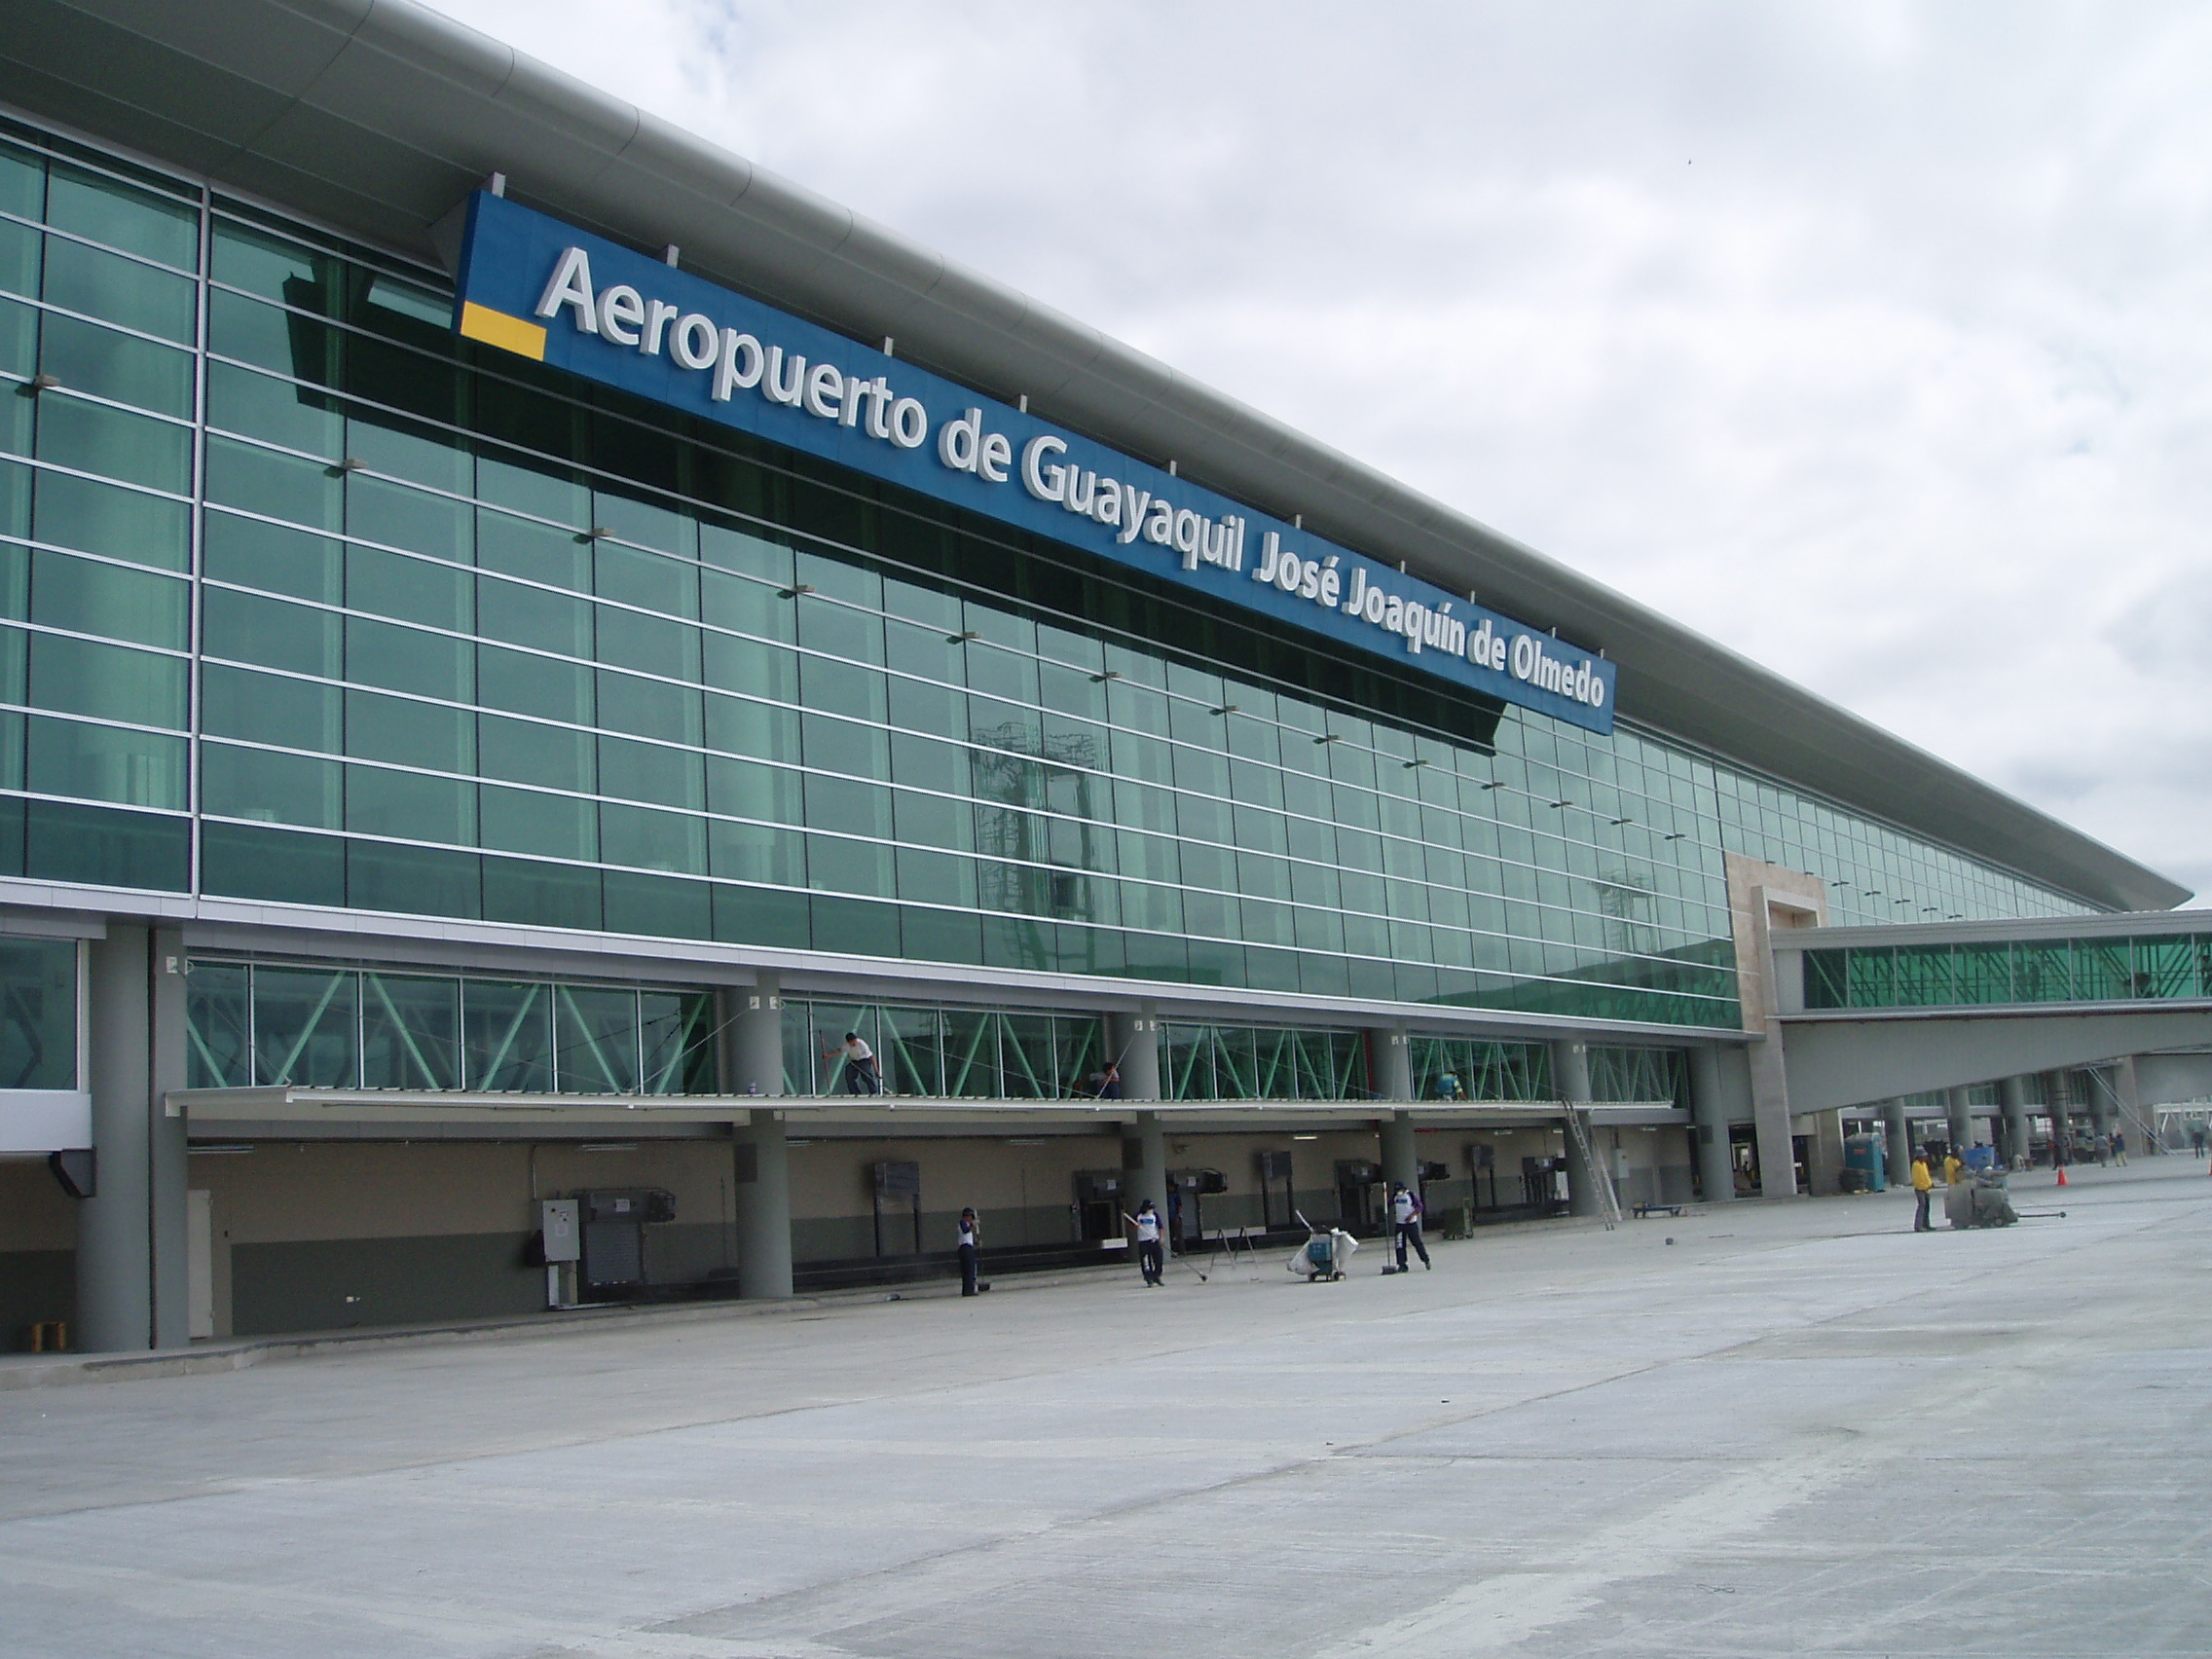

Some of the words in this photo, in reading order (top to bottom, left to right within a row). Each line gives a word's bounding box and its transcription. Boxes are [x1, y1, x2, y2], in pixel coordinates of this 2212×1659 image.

[535, 247, 928, 448] Aeropuerto
[940, 408, 1012, 482] de
[1022, 436, 1244, 571] Guayaquil
[1252, 532, 1340, 607] José
[1342, 568, 1466, 656] Joaquín
[1468, 620, 1505, 671] de
[1509, 635, 1604, 708] Olmedo
